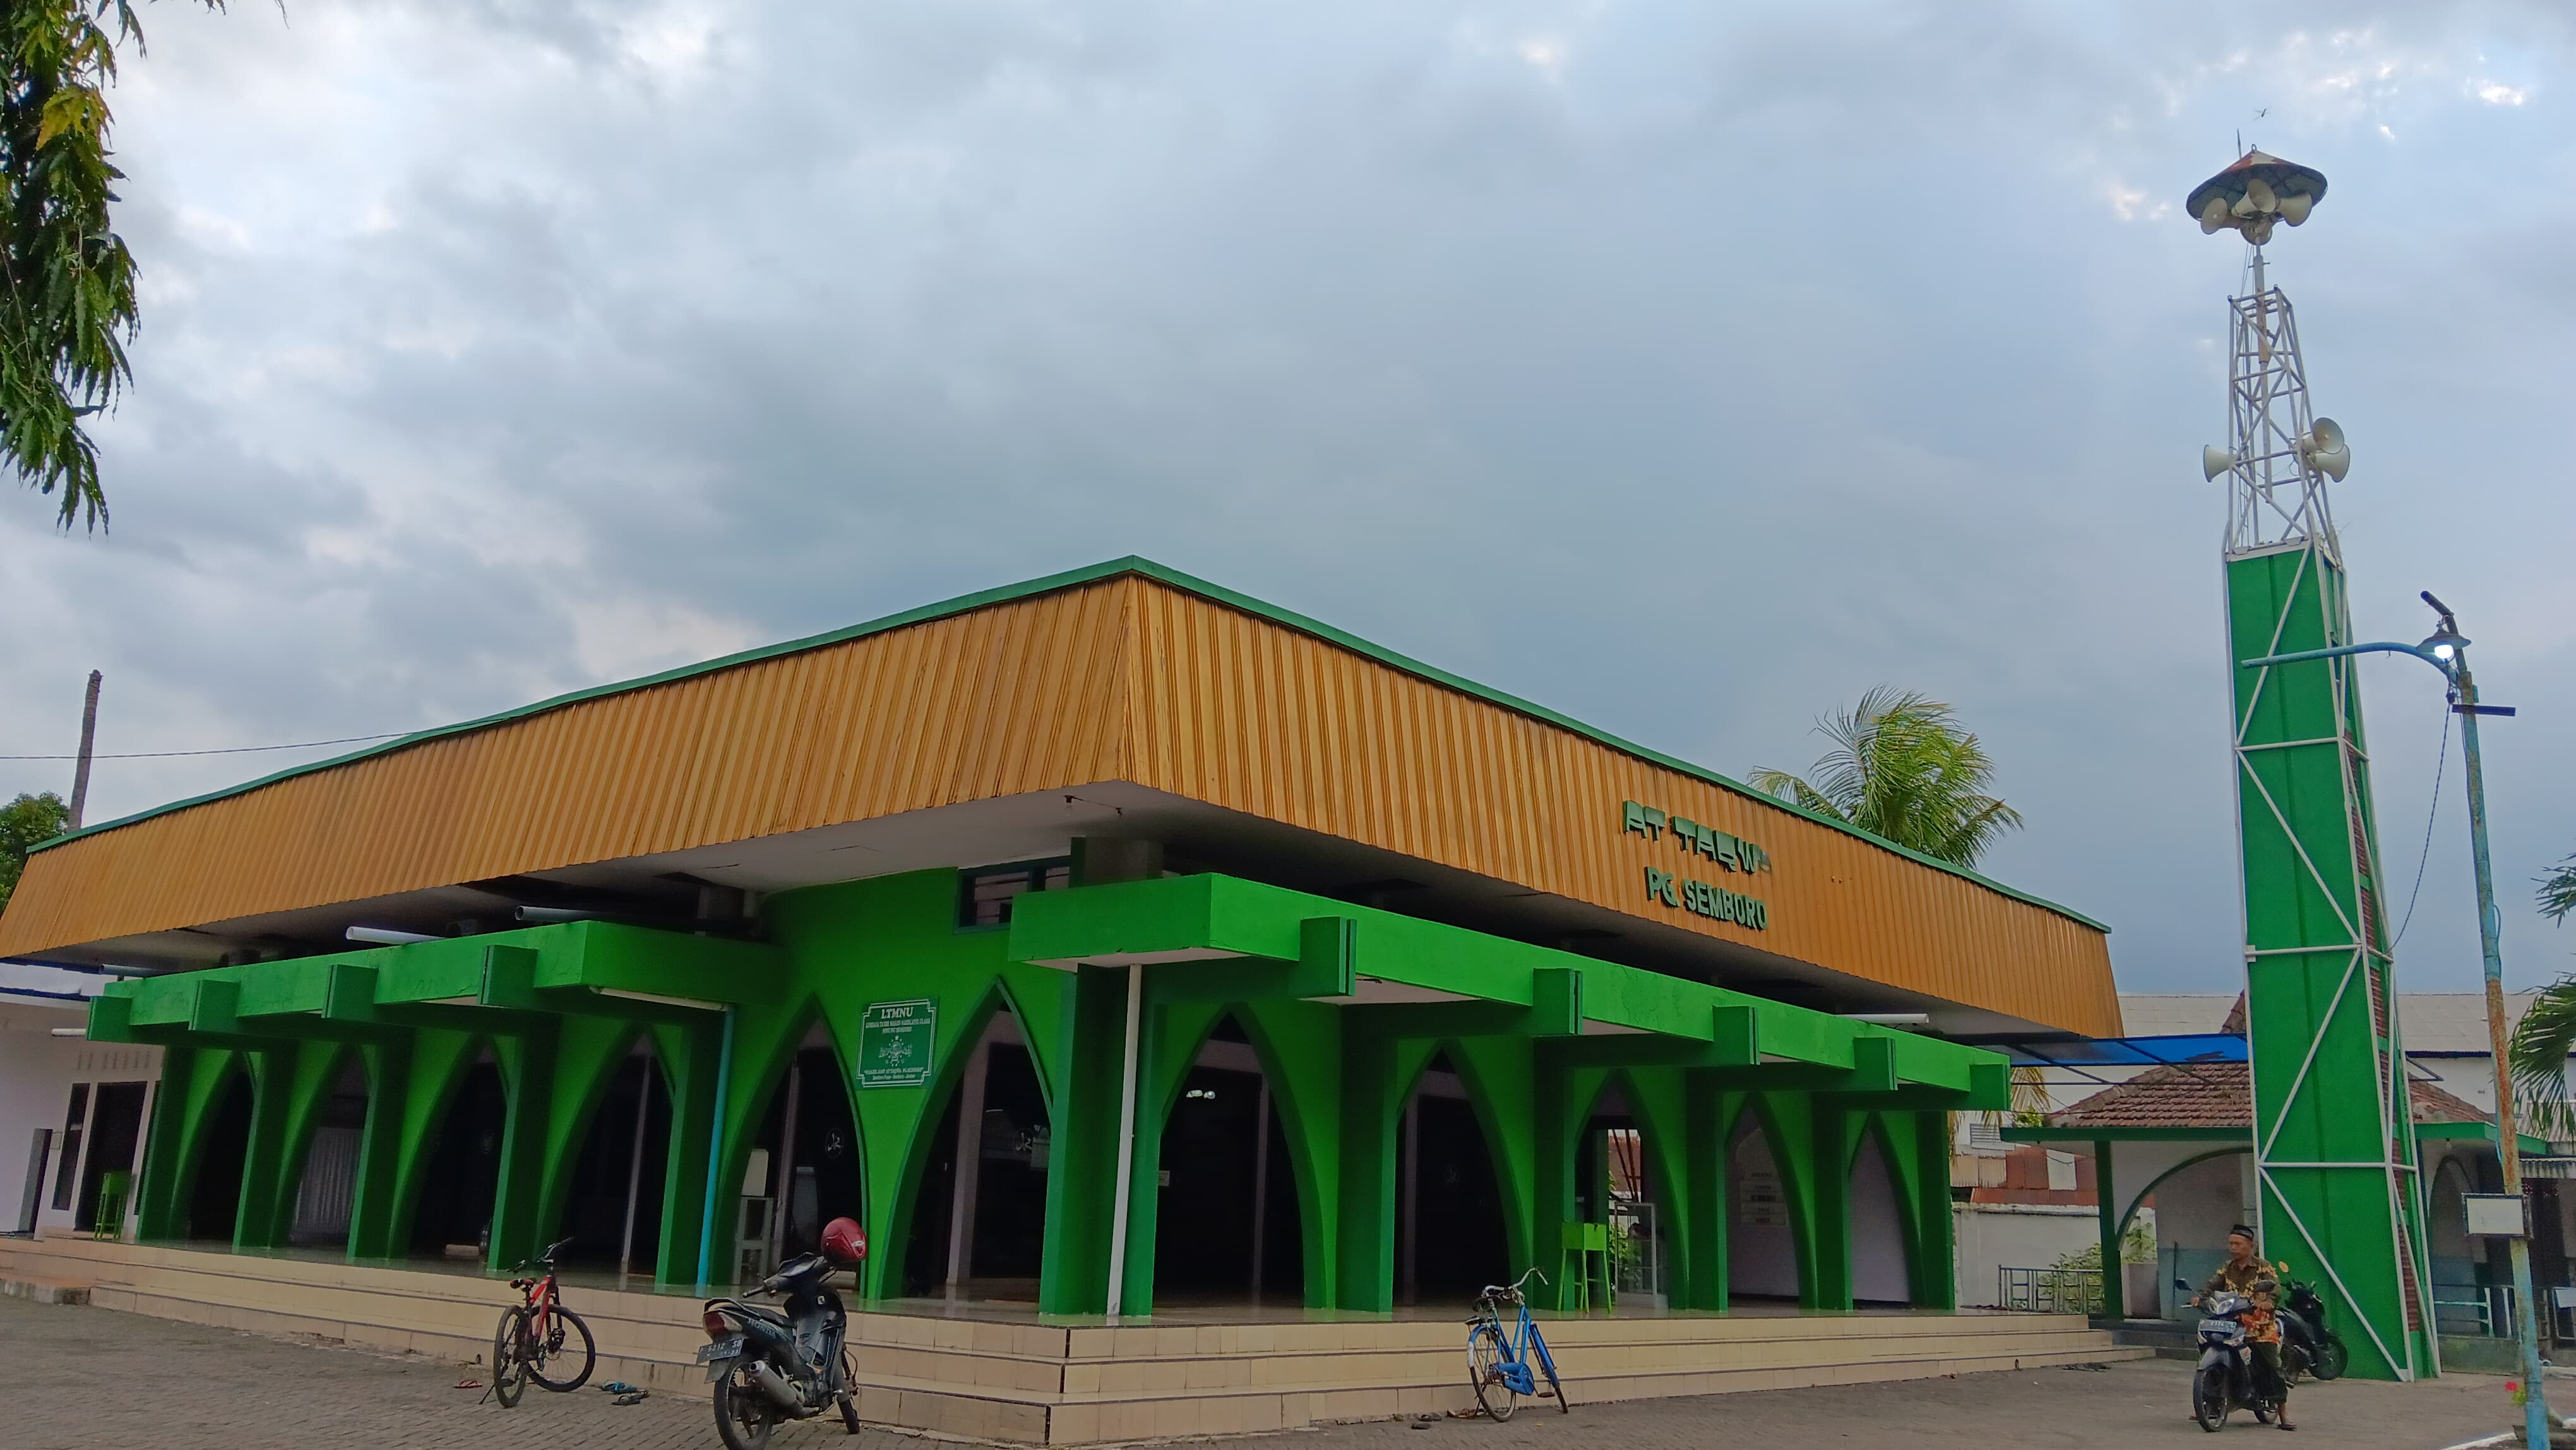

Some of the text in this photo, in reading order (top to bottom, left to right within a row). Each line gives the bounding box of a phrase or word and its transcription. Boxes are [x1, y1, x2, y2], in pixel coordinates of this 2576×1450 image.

[1623, 800, 1666, 841] AT
[1681, 878, 1768, 931] SEMBORO
[881, 1007, 914, 1019] LTMNU
[748, 1317, 776, 1339] HONDA
